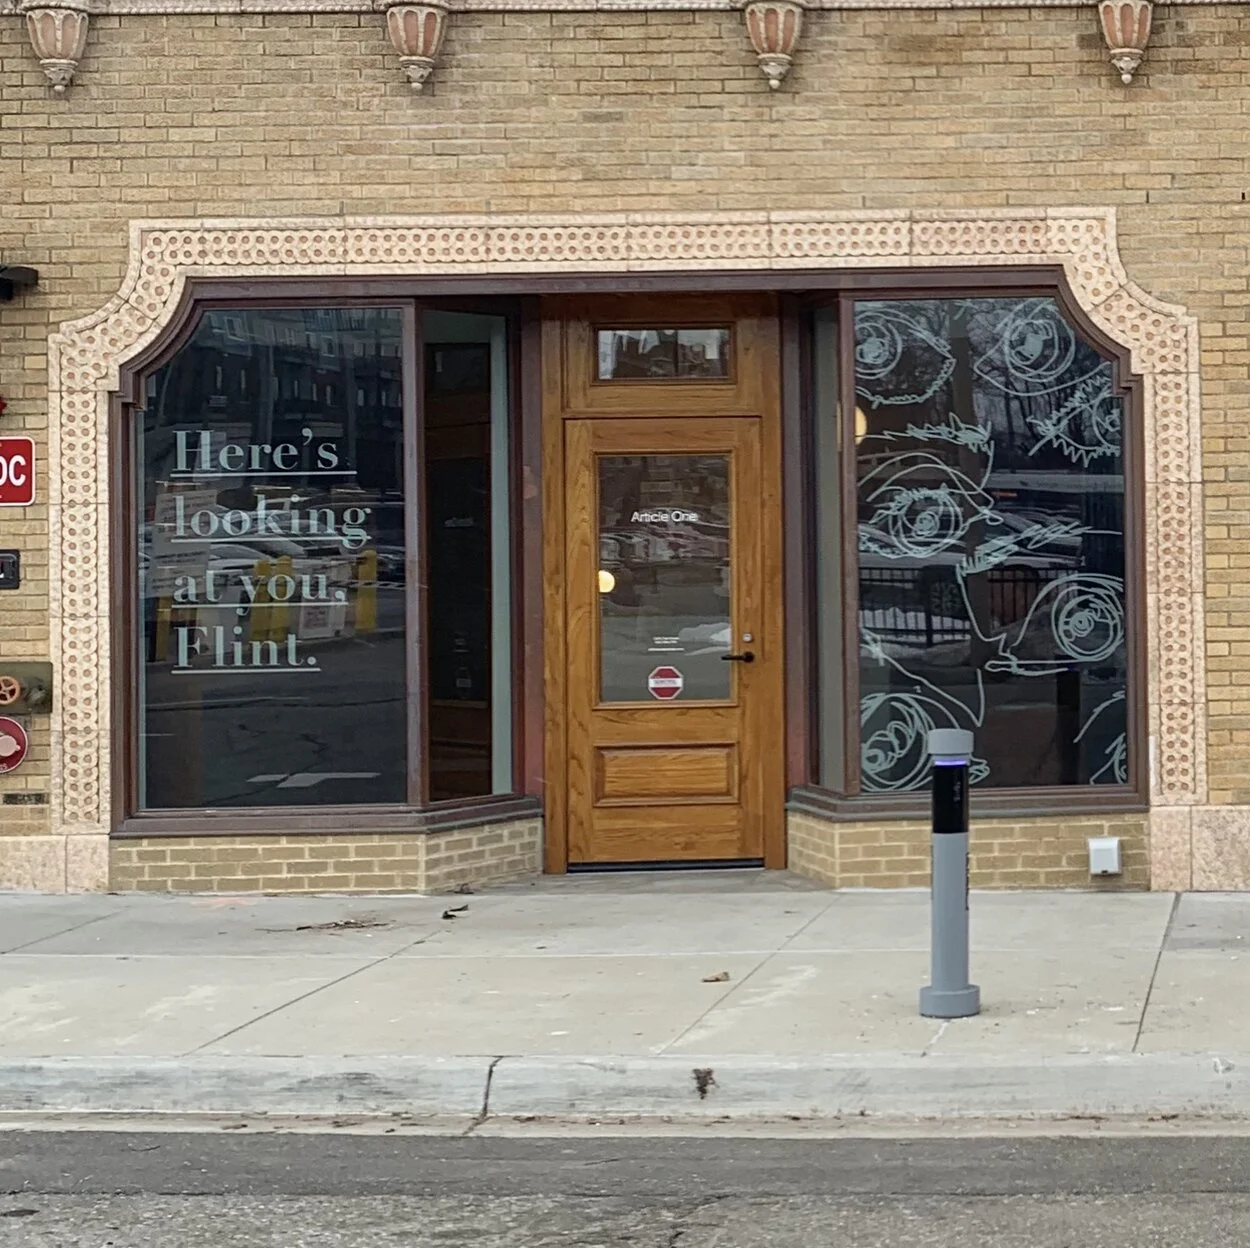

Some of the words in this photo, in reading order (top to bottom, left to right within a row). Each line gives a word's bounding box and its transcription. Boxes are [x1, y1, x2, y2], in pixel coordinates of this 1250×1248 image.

[172, 428, 340, 470] Here’s
[172, 494, 372, 549] looking
[630, 511, 669, 522] Article
[671, 510, 699, 522] One
[173, 570, 223, 602] at
[239, 573, 348, 616] you,
[172, 625, 317, 667] Flint.
